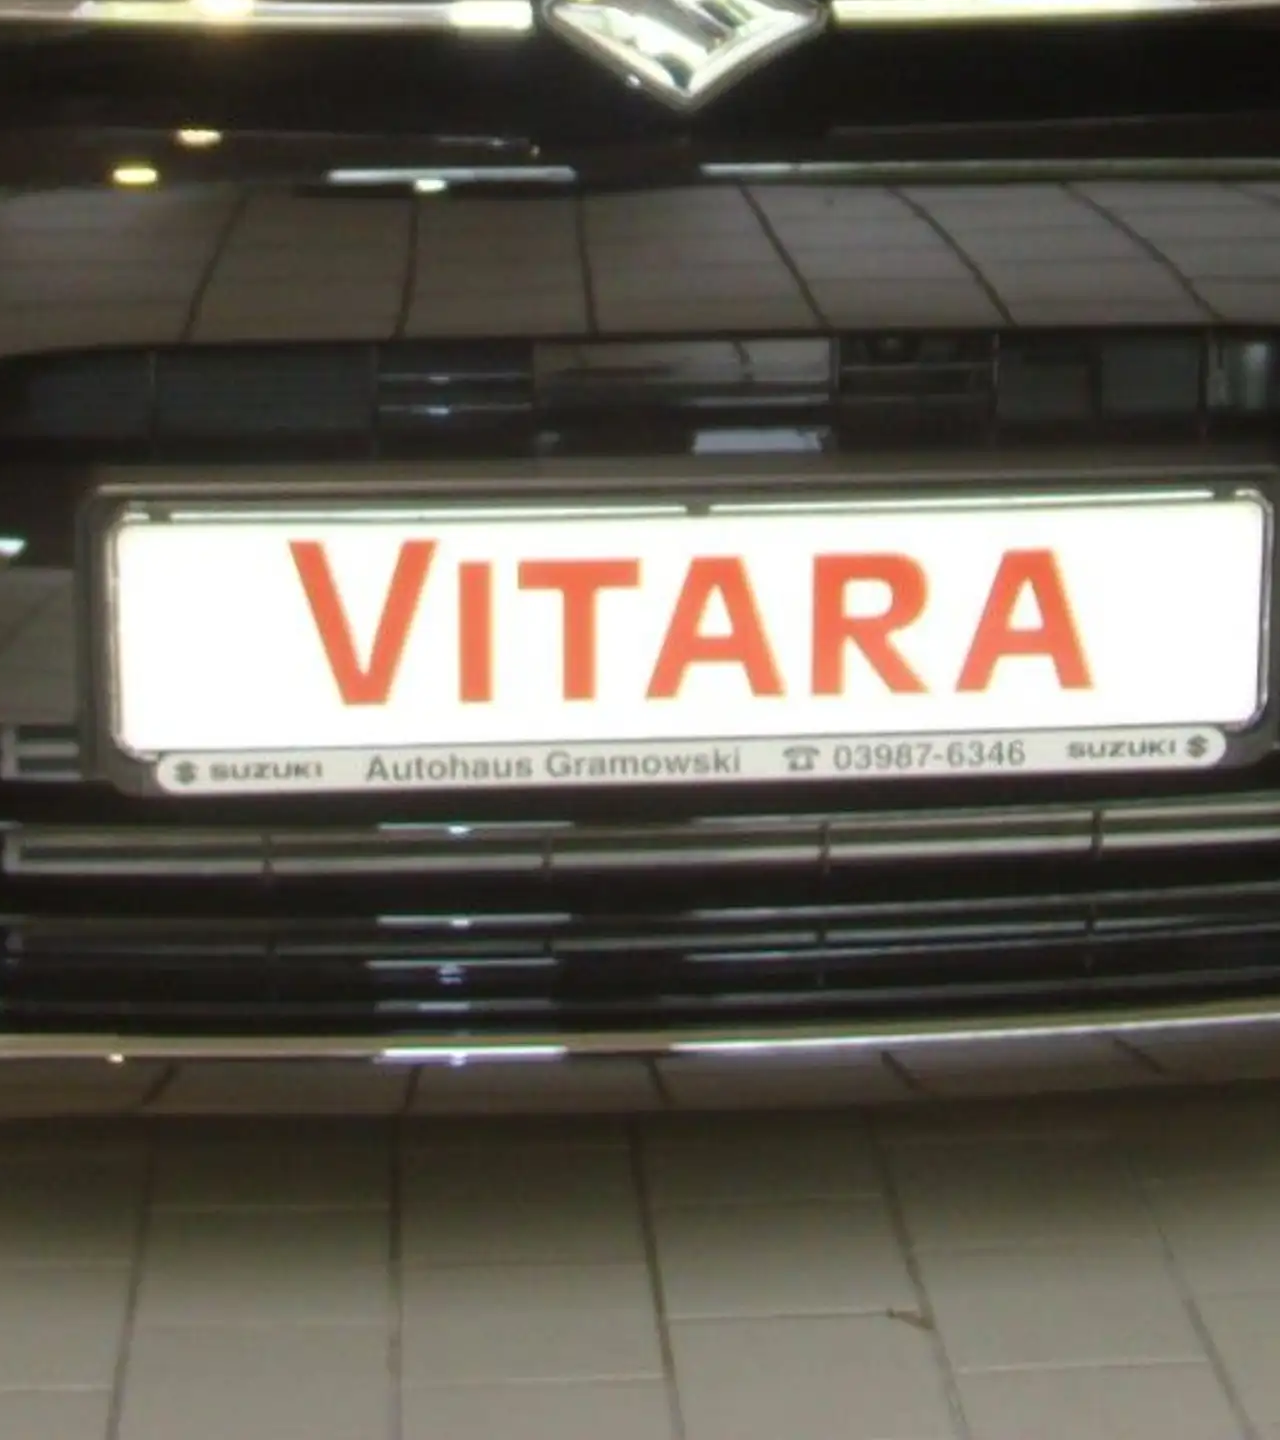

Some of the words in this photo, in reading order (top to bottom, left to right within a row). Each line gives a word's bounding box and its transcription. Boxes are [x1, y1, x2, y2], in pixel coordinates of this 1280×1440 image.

[288, 538, 1093, 707] VITARA
[208, 761, 324, 782] SUZUKI
[365, 753, 533, 783] Autohaus
[544, 746, 741, 779] Gramowski
[832, 740, 1027, 772] 03987-6346
[1065, 737, 1177, 759] SUZUKI
